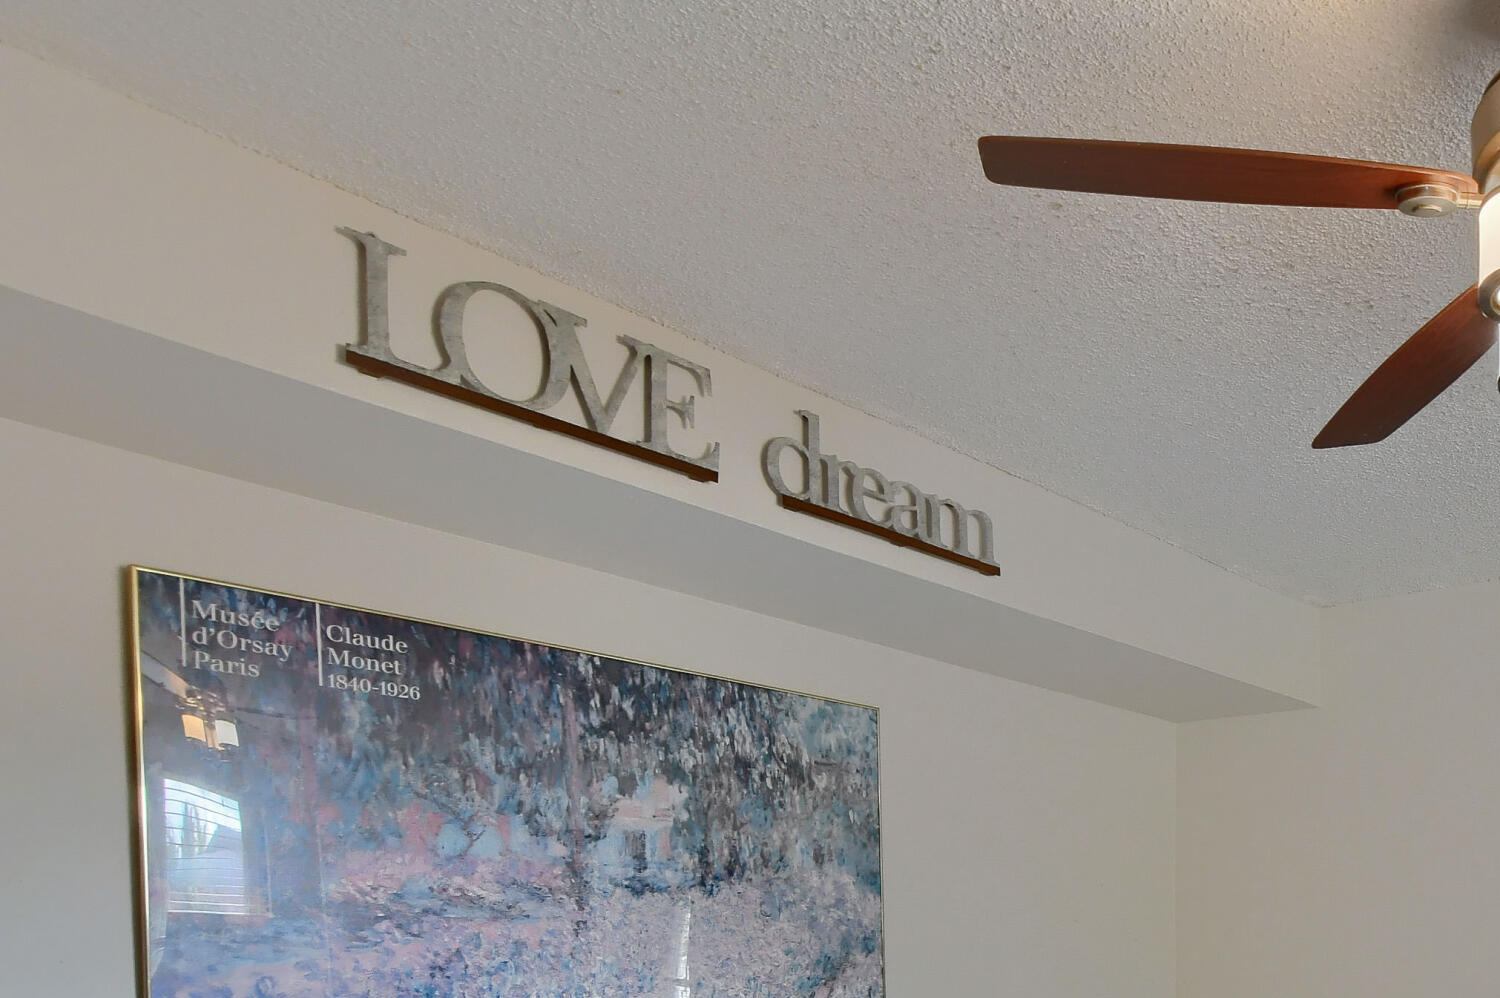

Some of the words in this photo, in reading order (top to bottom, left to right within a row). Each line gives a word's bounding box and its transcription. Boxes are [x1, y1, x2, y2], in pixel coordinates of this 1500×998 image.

[336, 226, 720, 466] LOVE
[762, 410, 1000, 568] dream
[191, 600, 281, 632] Musée
[191, 627, 293, 662] d'Orsay
[326, 623, 409, 654] Claude
[193, 651, 260, 678] Paris
[327, 648, 402, 676] Monet
[327, 674, 421, 701] 1840-1926
